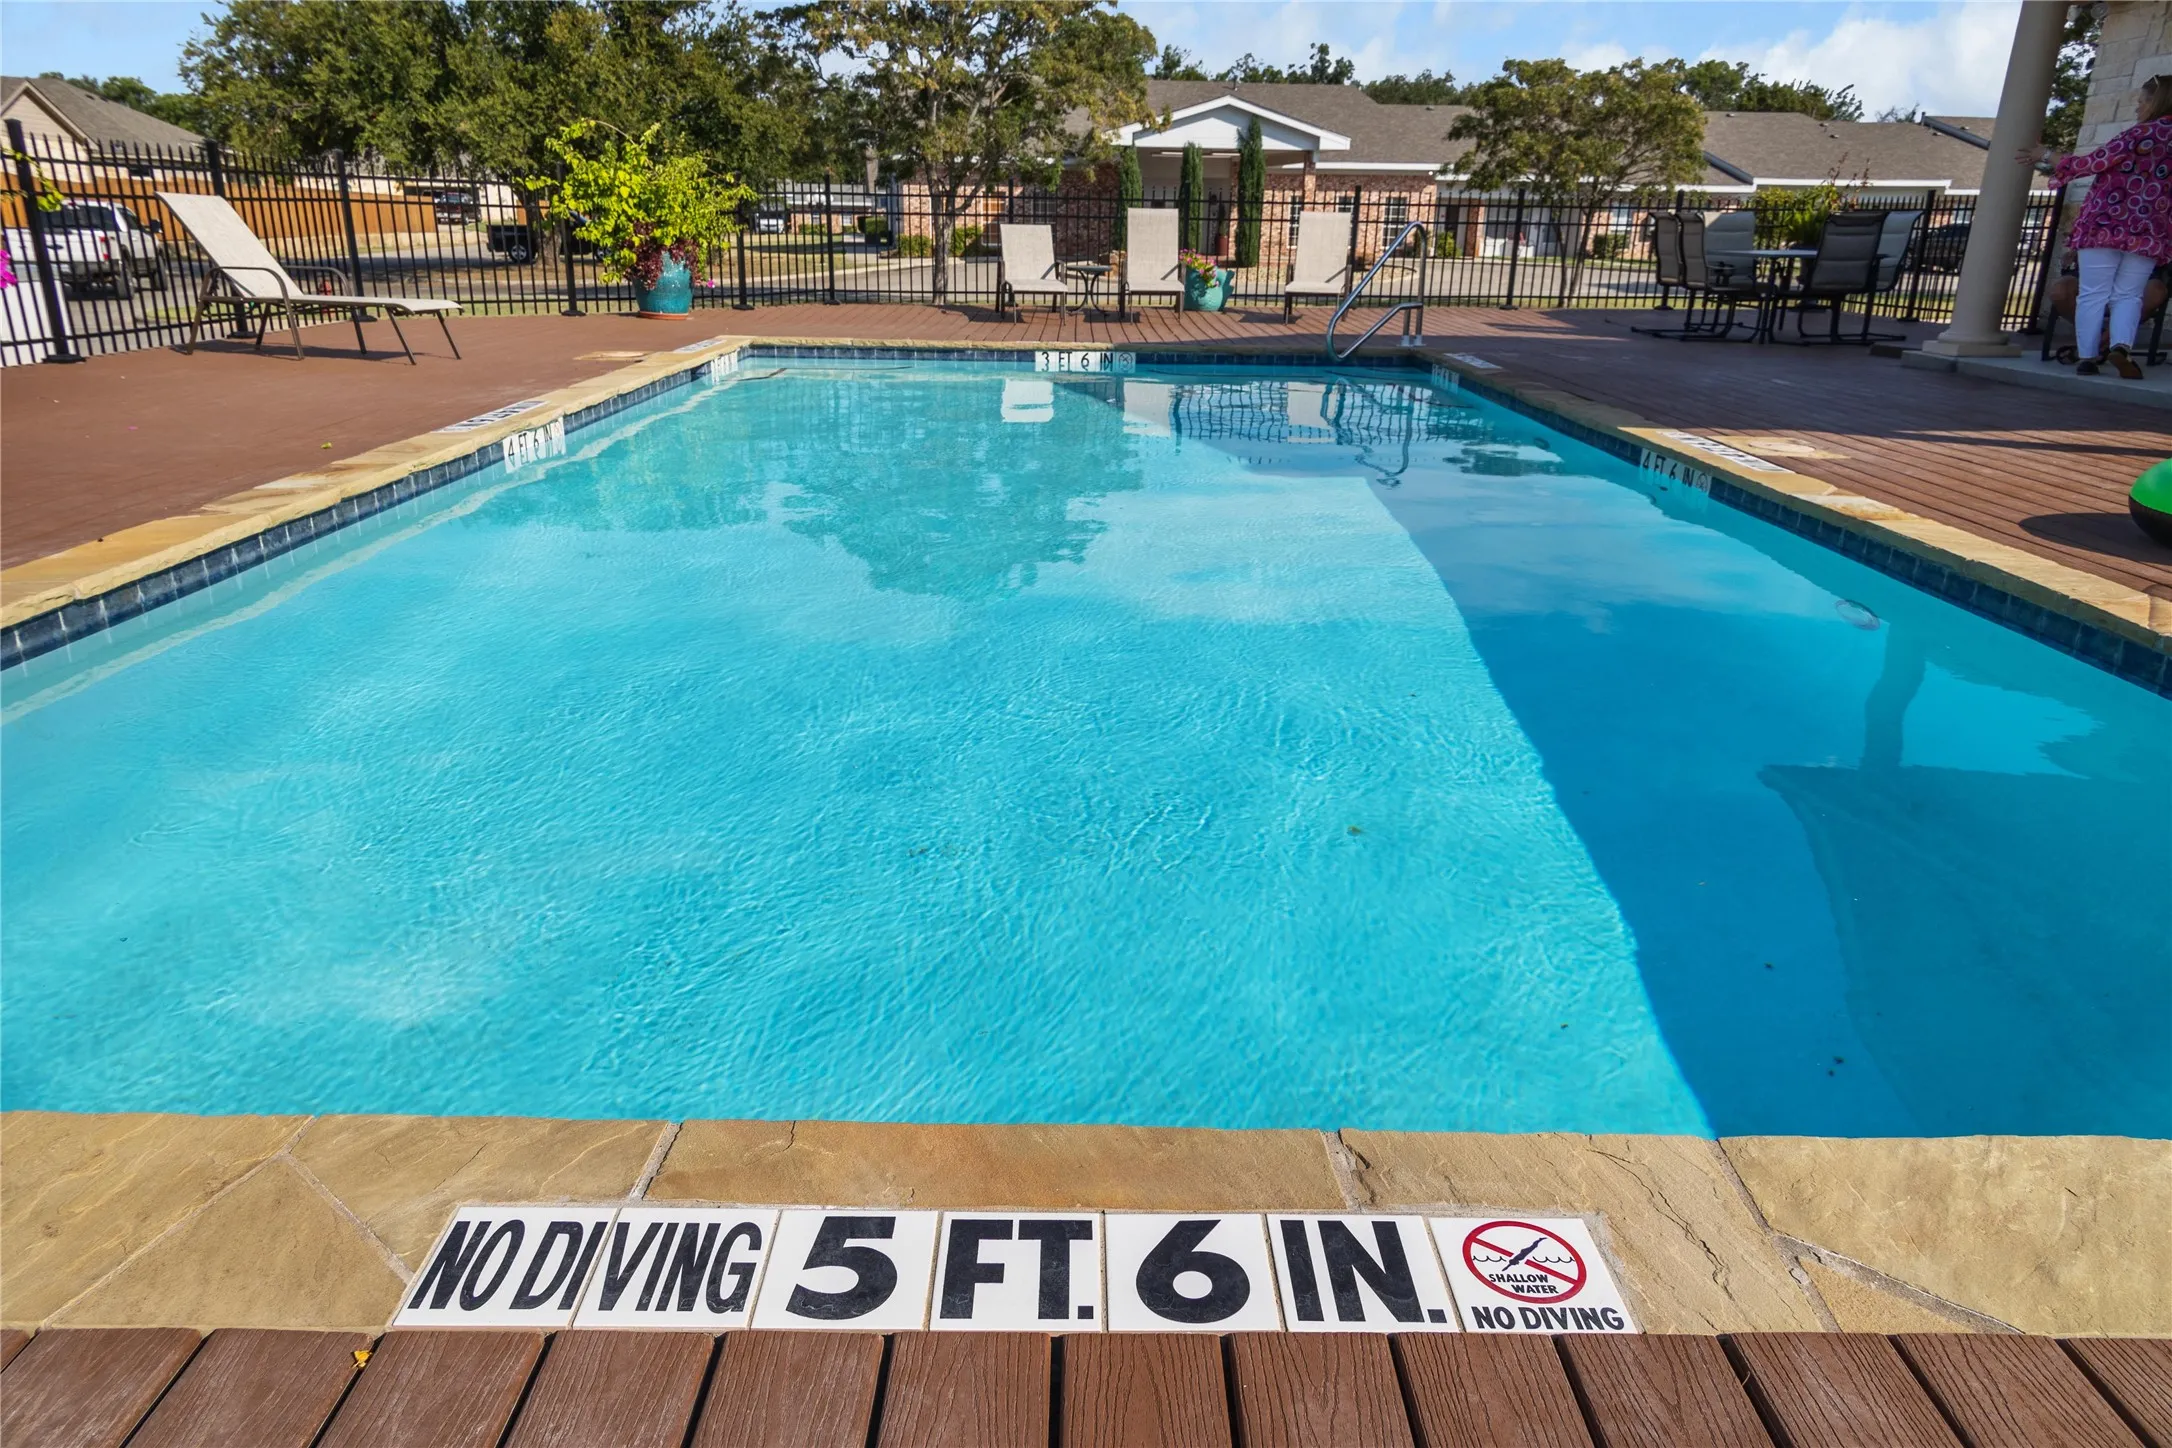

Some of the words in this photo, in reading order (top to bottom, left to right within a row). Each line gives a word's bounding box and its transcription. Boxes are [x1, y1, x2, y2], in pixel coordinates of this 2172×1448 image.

[1041, 351, 1050, 364] 3
[1058, 351, 1073, 364] FT
[1080, 352, 1089, 367] 6
[1099, 352, 1114, 365] IN
[508, 437, 515, 457] 4
[518, 432, 528, 452] FT
[533, 429, 540, 449] 6
[1642, 451, 1651, 470] 4
[1654, 453, 1666, 475] FT
[1668, 462, 1677, 481] 6
[1682, 466, 1695, 488] IN
[407, 1219, 526, 1312] NO
[516, 1220, 763, 1314] DIVING
[785, 1215, 899, 1321] 5
[939, 1219, 1095, 1321] FT.
[1135, 1218, 1252, 1324] 6
[1279, 1219, 1448, 1324] IN.
[1488, 1273, 1549, 1284] SHALLOW
[1510, 1284, 1560, 1295] WATER
[1471, 1306, 1516, 1330] NO
[1518, 1306, 1625, 1331] DIVING
